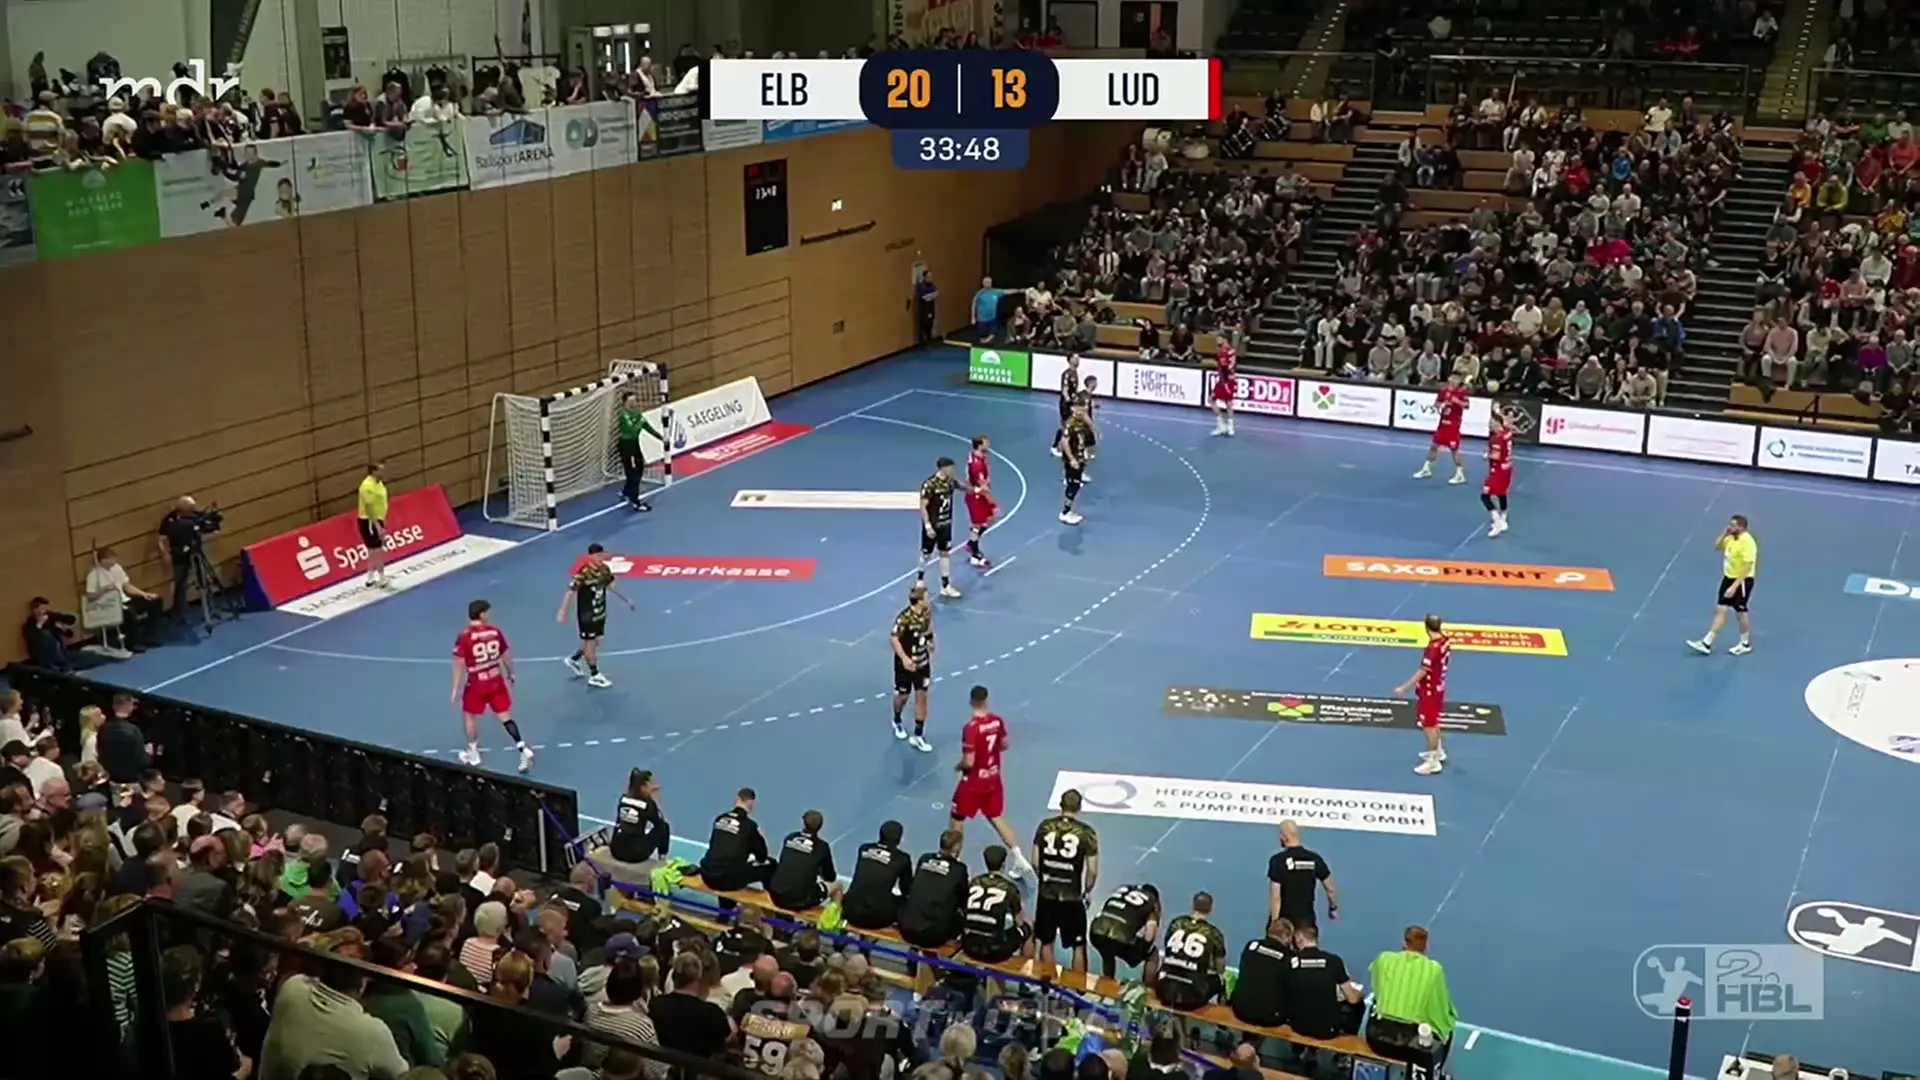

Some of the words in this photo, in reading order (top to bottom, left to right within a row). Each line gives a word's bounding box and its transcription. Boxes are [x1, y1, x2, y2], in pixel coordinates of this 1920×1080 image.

[687, 400, 743, 429] SAEGELING
[333, 523, 424, 571] Spaasse
[644, 564, 791, 577] Sparkasse
[1346, 562, 1547, 581] SAXOPRINT
[1313, 622, 1397, 634] LOTTO
[472, 640, 499, 663] 99
[985, 734, 997, 753] 7
[1156, 787, 1233, 801] HERZOG
[1241, 793, 1424, 814] ELEKTROMOTOREN
[1180, 802, 1353, 822] PUMPENSERVICE
[1363, 813, 1425, 827] GMBH
[1043, 831, 1080, 859] 13
[967, 886, 1007, 911] 27
[1167, 929, 1208, 958] 46
[743, 1034, 788, 1076] 59
